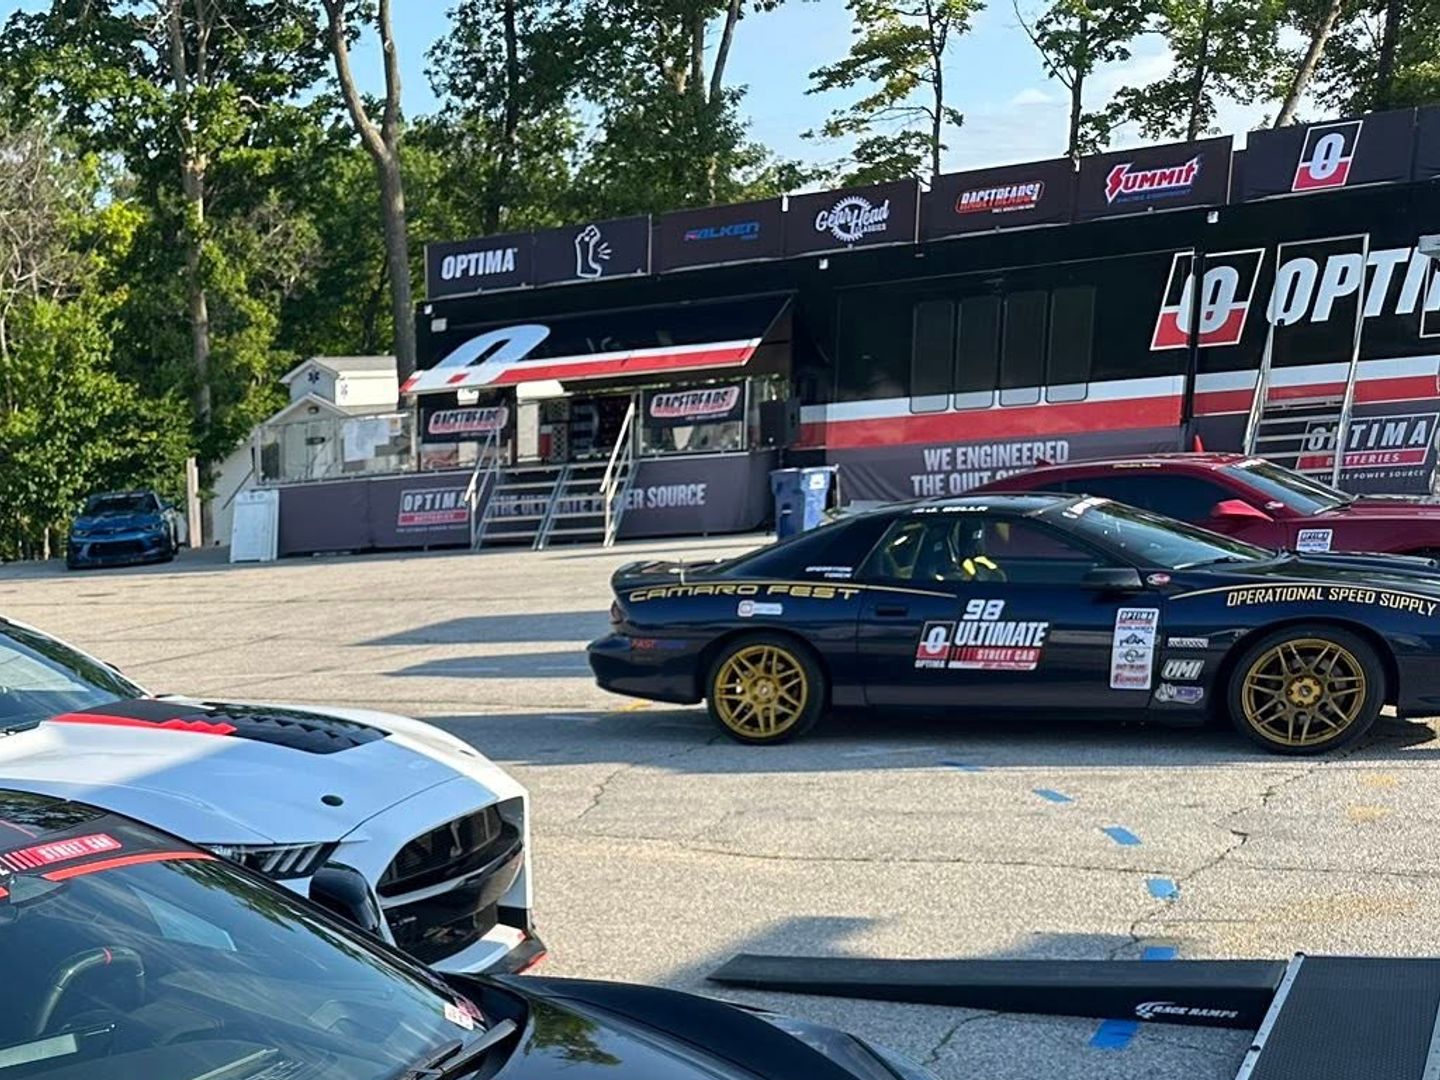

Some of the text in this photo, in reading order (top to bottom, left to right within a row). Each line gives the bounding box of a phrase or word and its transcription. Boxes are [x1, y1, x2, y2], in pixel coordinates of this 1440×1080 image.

[683, 221, 761, 241] FALKEN
[441, 249, 515, 280] OPTIMA
[924, 441, 1069, 471] WE ENGINEERED
[1326, 453, 1400, 466] BTTERIES
[911, 474, 946, 497] THE
[1353, 472, 1384, 480] POWER
[1389, 470, 1424, 479] SOURCE
[403, 491, 467, 512] OPTIMA
[647, 484, 707, 508] SOURCE
[629, 585, 859, 602] CAMARO FEST
[1226, 587, 1436, 617] OPERATIONAL SPEED SUPPLY
[962, 599, 1005, 620] 98
[954, 621, 1049, 647] ULTIMATE
[976, 649, 1035, 661] STREET CAR
[40, 840, 86, 863] STREET
[87, 834, 121, 852] CAR
[1188, 1008, 1239, 1018] RAMPS
